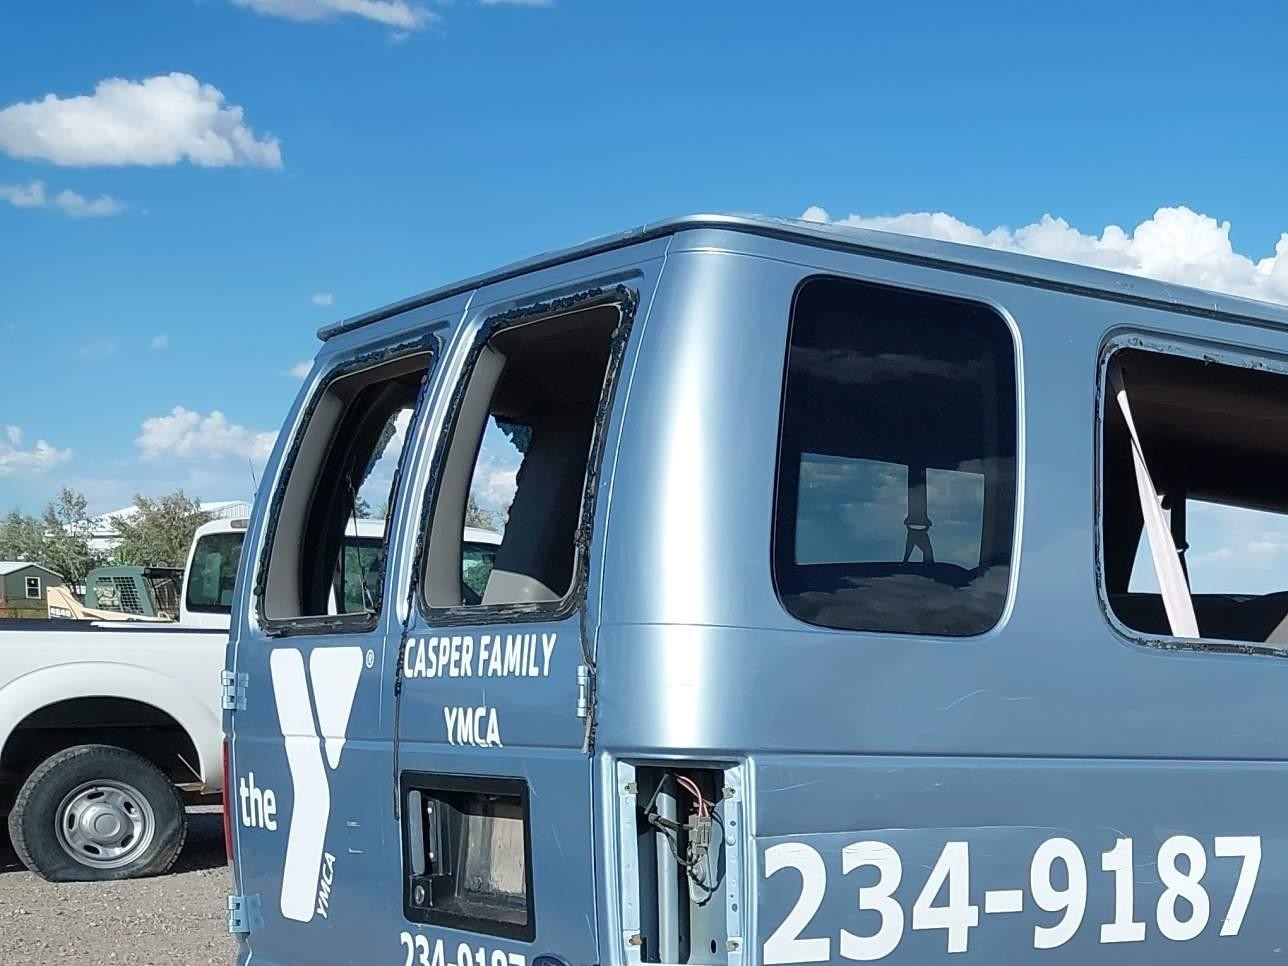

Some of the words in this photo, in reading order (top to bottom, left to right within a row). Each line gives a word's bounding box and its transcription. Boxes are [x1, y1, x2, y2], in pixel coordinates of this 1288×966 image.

[403, 635, 474, 678] CASPER
[478, 633, 557, 677] FAMILY
[444, 706, 503, 748] YMCA
[239, 771, 277, 831] the
[315, 852, 337, 920] YMCA
[762, 835, 1263, 966] 234-9187
